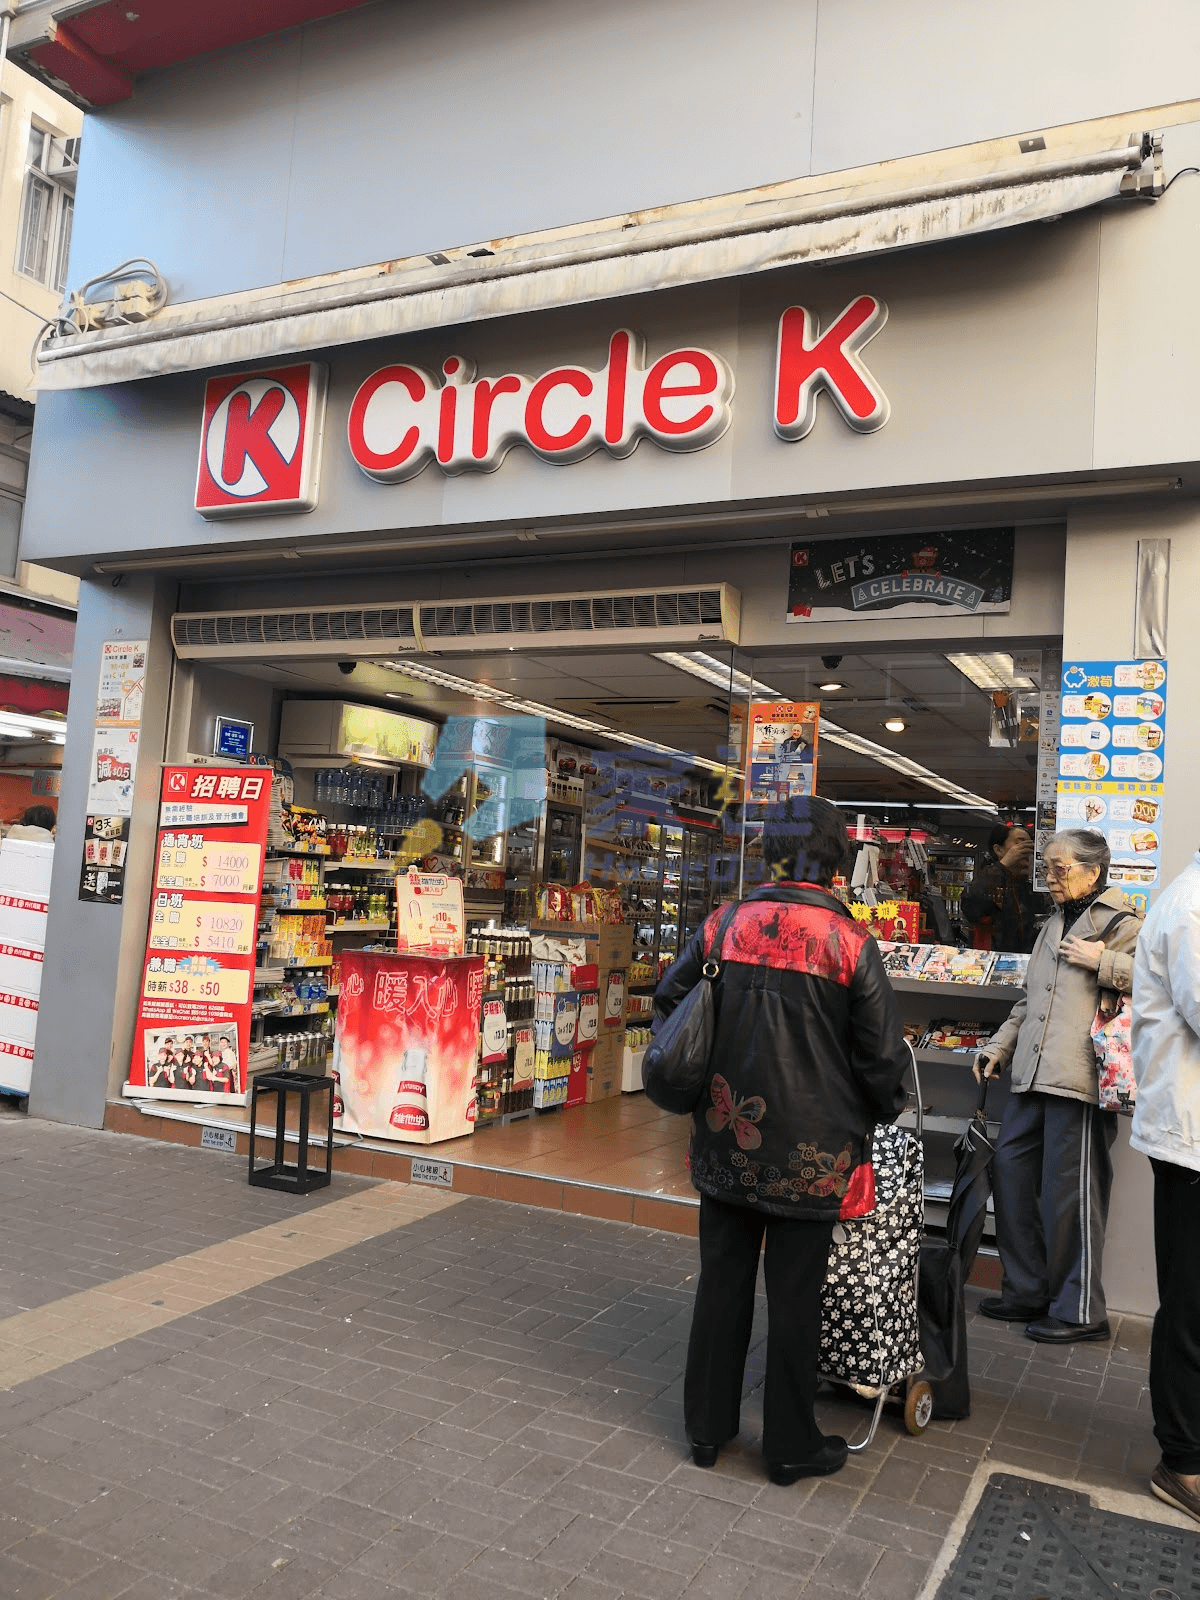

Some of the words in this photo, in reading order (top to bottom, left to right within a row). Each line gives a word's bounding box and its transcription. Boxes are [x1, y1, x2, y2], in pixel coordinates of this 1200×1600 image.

[347, 329, 721, 471] Circle
[774, 295, 878, 427] K
[814, 549, 875, 589] LET'S
[870, 578, 966, 600] CELEBRATE
[113, 645, 132, 653] Circle
[190, 774, 264, 800] 招聘日
[95, 817, 112, 832] 3天
[162, 832, 204, 849] 通宵班
[218, 855, 249, 869] 14000
[213, 874, 240, 887] 7000
[156, 892, 183, 908] 日班
[210, 917, 243, 931] 10820
[207, 935, 235, 949] 5410
[148, 980, 168, 992] 時薪
[169, 979, 189, 994] $38
[200, 981, 220, 996] $50
[393, 1112, 426, 1127] 維他奶
[412, 1163, 439, 1175] 小心梯級
